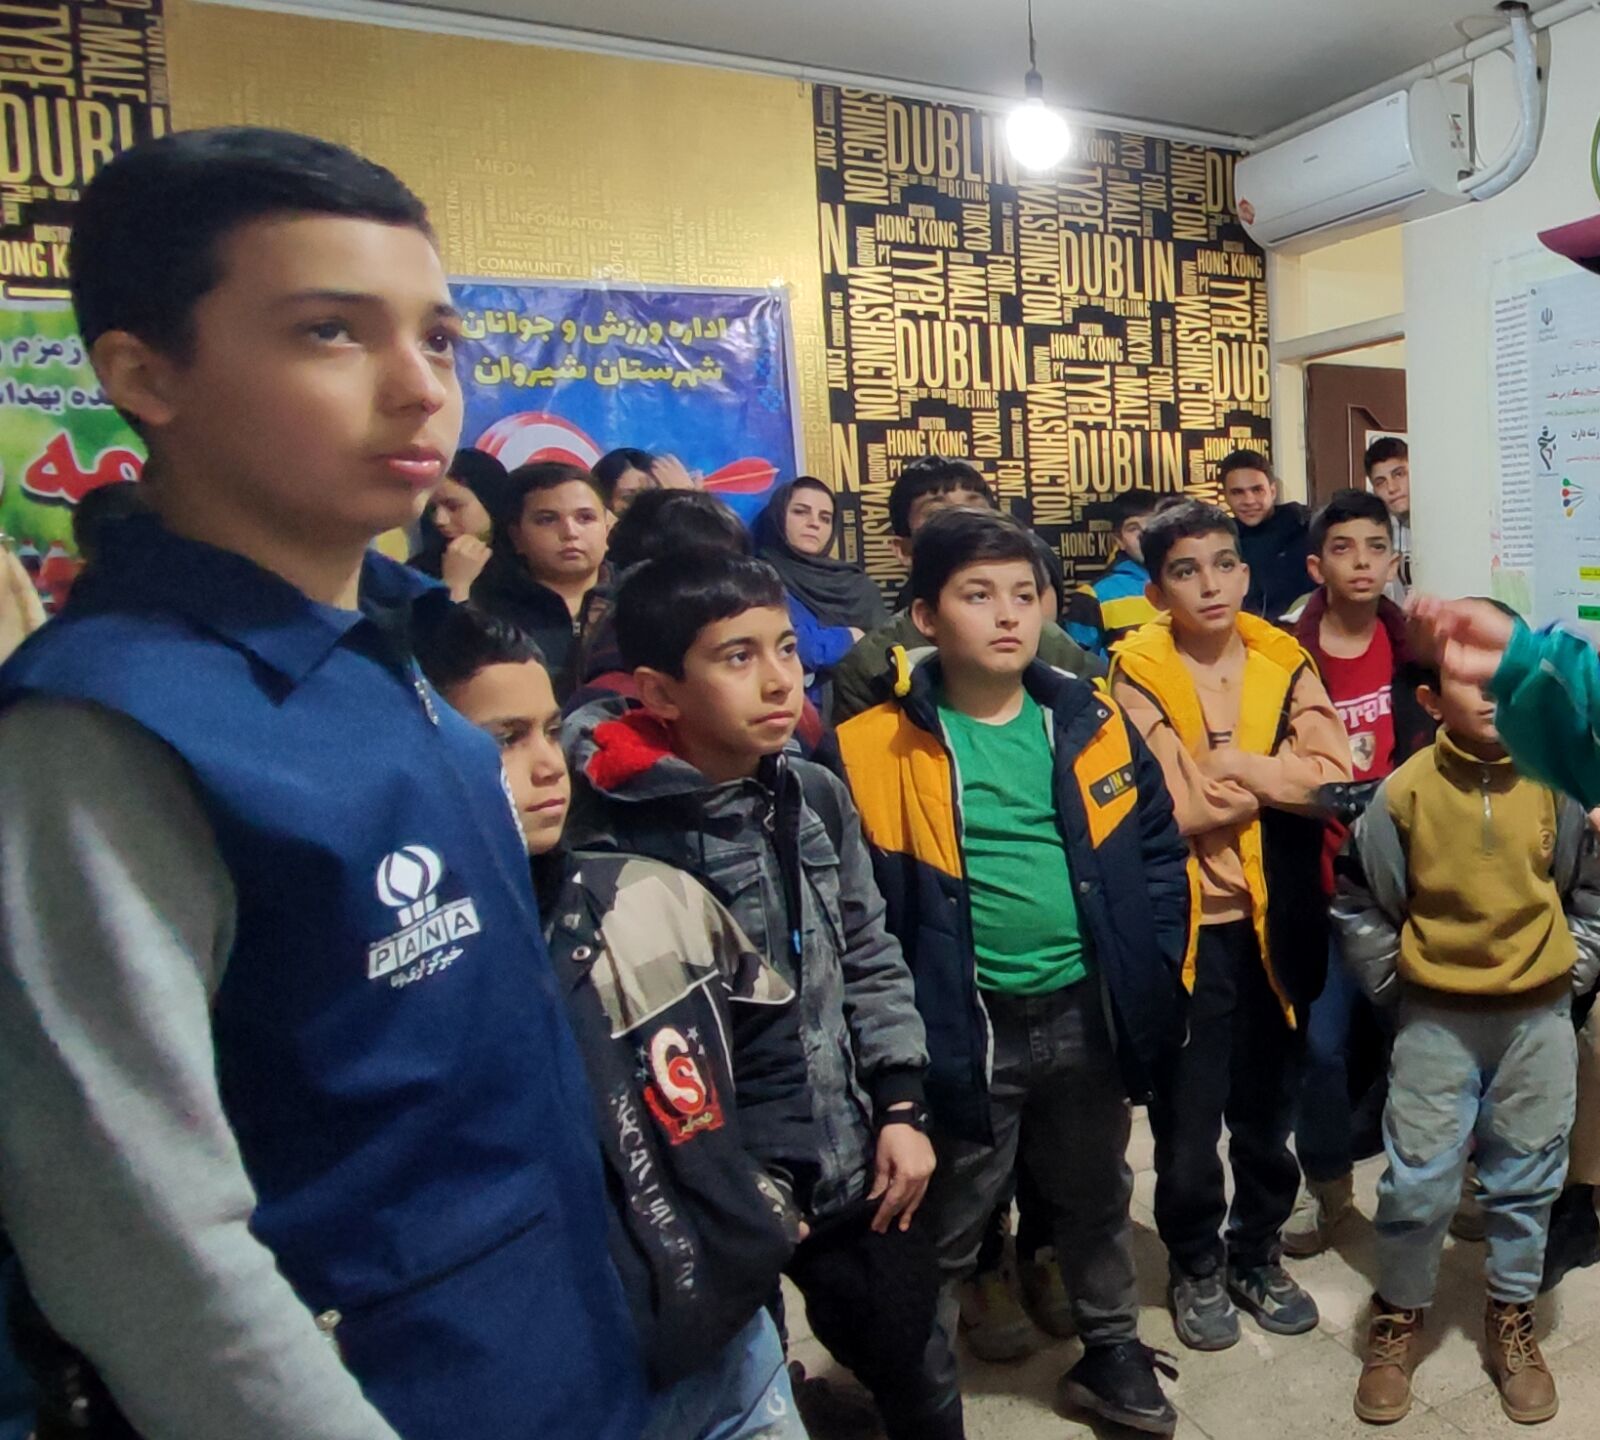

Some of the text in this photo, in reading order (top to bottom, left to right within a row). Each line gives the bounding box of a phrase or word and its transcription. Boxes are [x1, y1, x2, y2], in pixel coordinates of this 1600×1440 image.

[78, 23, 147, 103] MALE
[948, 179, 990, 202] BEIJING
[876, 213, 958, 249] HONG KONG
[962, 203, 991, 251] TOKYO
[0, 240, 48, 278] ONG
[986, 255, 1016, 296] FONT
[1059, 229, 1175, 304] DUBLIN
[1197, 249, 1262, 279] HONG KONG
[891, 250, 946, 321] TYPE
[947, 264, 988, 324] MALE
[1114, 299, 1151, 318] BEIJING
[462, 309, 728, 346] اداره ورزش و جوانان
[1209, 281, 1253, 342] TYPE
[848, 266, 900, 421] WASHINGTON
[895, 318, 1027, 394] DUBLIN
[1050, 332, 1124, 363] HONG KONG
[1126, 319, 1153, 365] TOKYO
[1175, 295, 1216, 431] WASHINGTON
[474, 354, 723, 388] شهرستان شیروان
[1148, 366, 1175, 405] FONT
[957, 389, 999, 409] BEIJING
[1065, 364, 1113, 430] TYPE
[1114, 377, 1150, 431] MALE
[886, 429, 969, 457] HONG KONG
[971, 410, 1002, 458] TOKYO
[1026, 381, 1073, 526] WASHINGTON
[867, 443, 888, 483] MADRID
[996, 460, 1027, 499] FONT
[1067, 430, 1184, 494] DUBLIN
[374, 910, 475, 973] PANA
